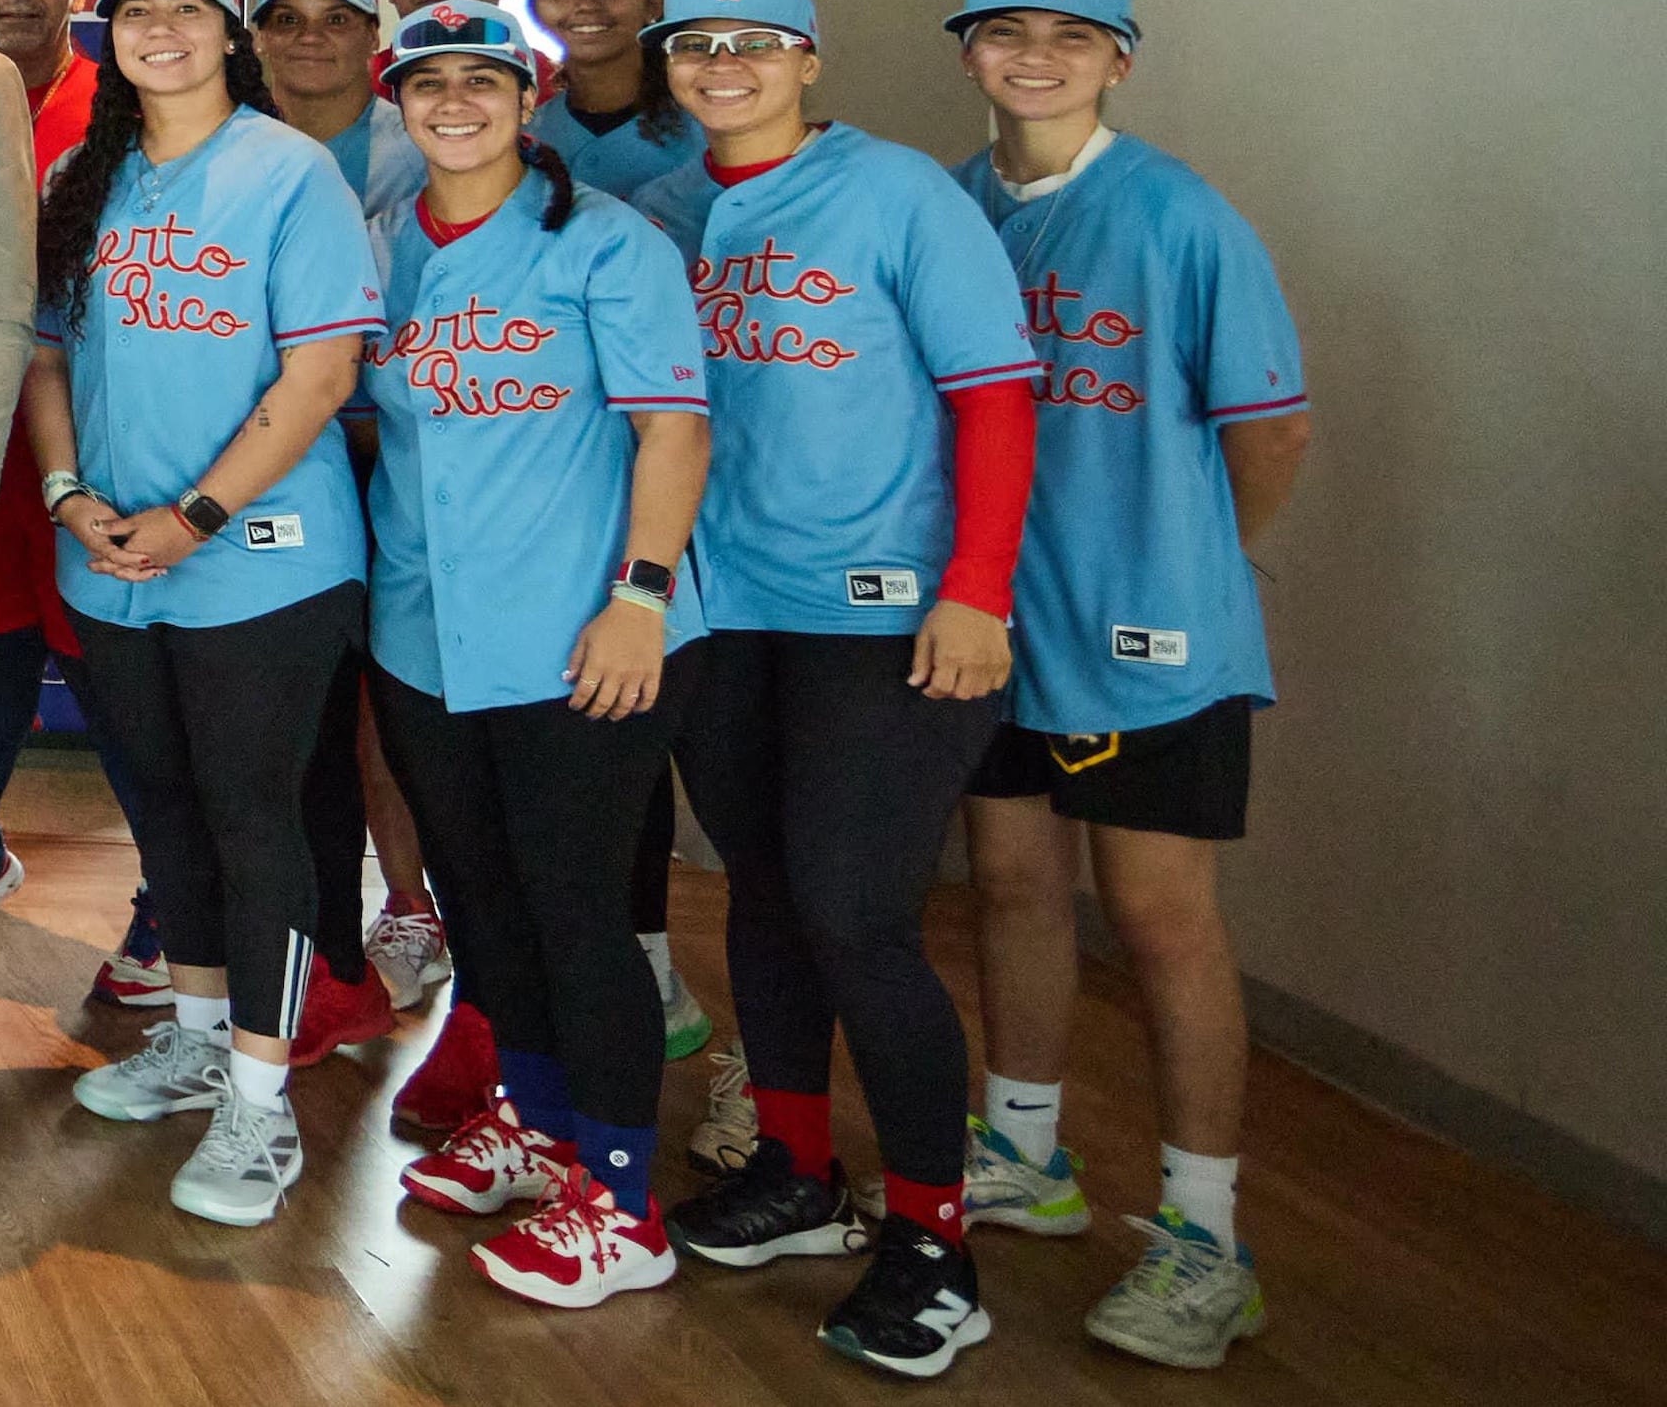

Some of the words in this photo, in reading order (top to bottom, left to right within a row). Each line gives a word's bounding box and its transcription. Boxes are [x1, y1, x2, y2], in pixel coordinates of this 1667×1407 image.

[105, 261, 250, 337] Rico
[696, 292, 858, 370] Rico
[408, 349, 571, 418] Rico
